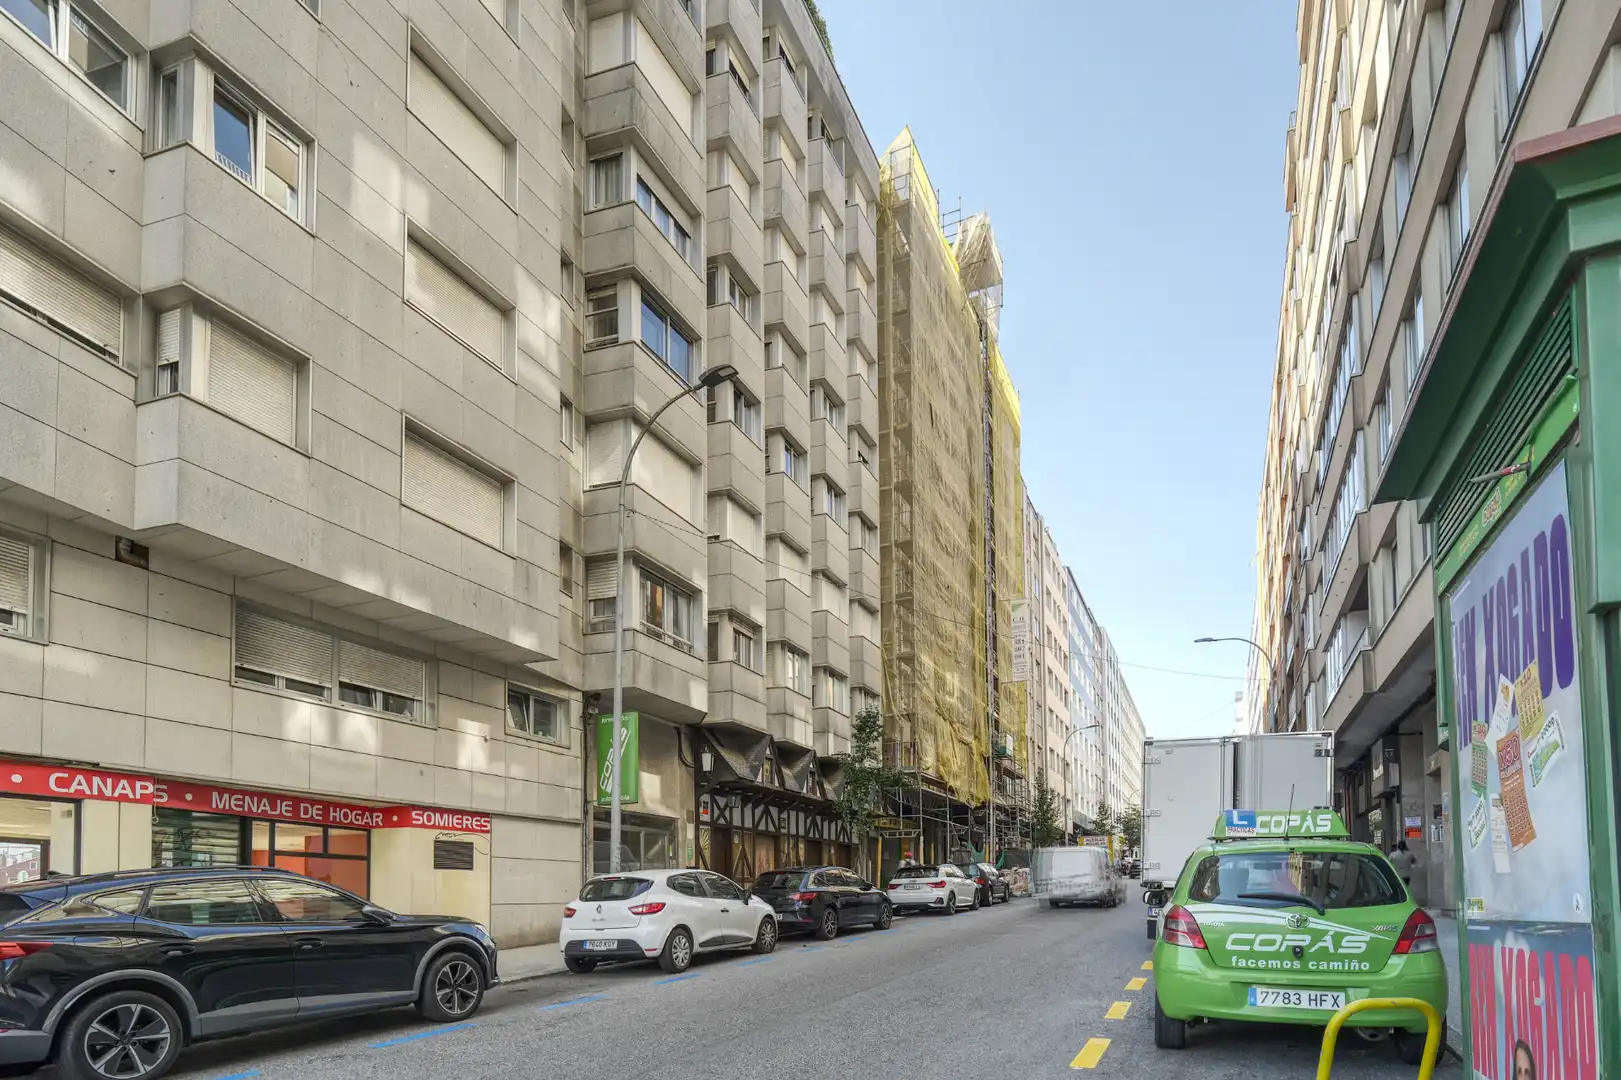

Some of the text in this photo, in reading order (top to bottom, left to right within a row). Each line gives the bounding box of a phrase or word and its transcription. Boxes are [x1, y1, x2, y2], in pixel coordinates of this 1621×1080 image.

[600, 727, 628, 792] COPS
[211, 791, 384, 827] MENAJE DE HOGAR
[411, 810, 491, 831] SOMIERES
[1233, 811, 1248, 825] L
[1256, 810, 1332, 834] COPÁS
[1225, 931, 1372, 954] COPÁS
[1231, 955, 1370, 970] facemos camiño
[1260, 990, 1340, 1008] 7783 HFX
[1468, 942, 1597, 1080] BEN XOGADO
